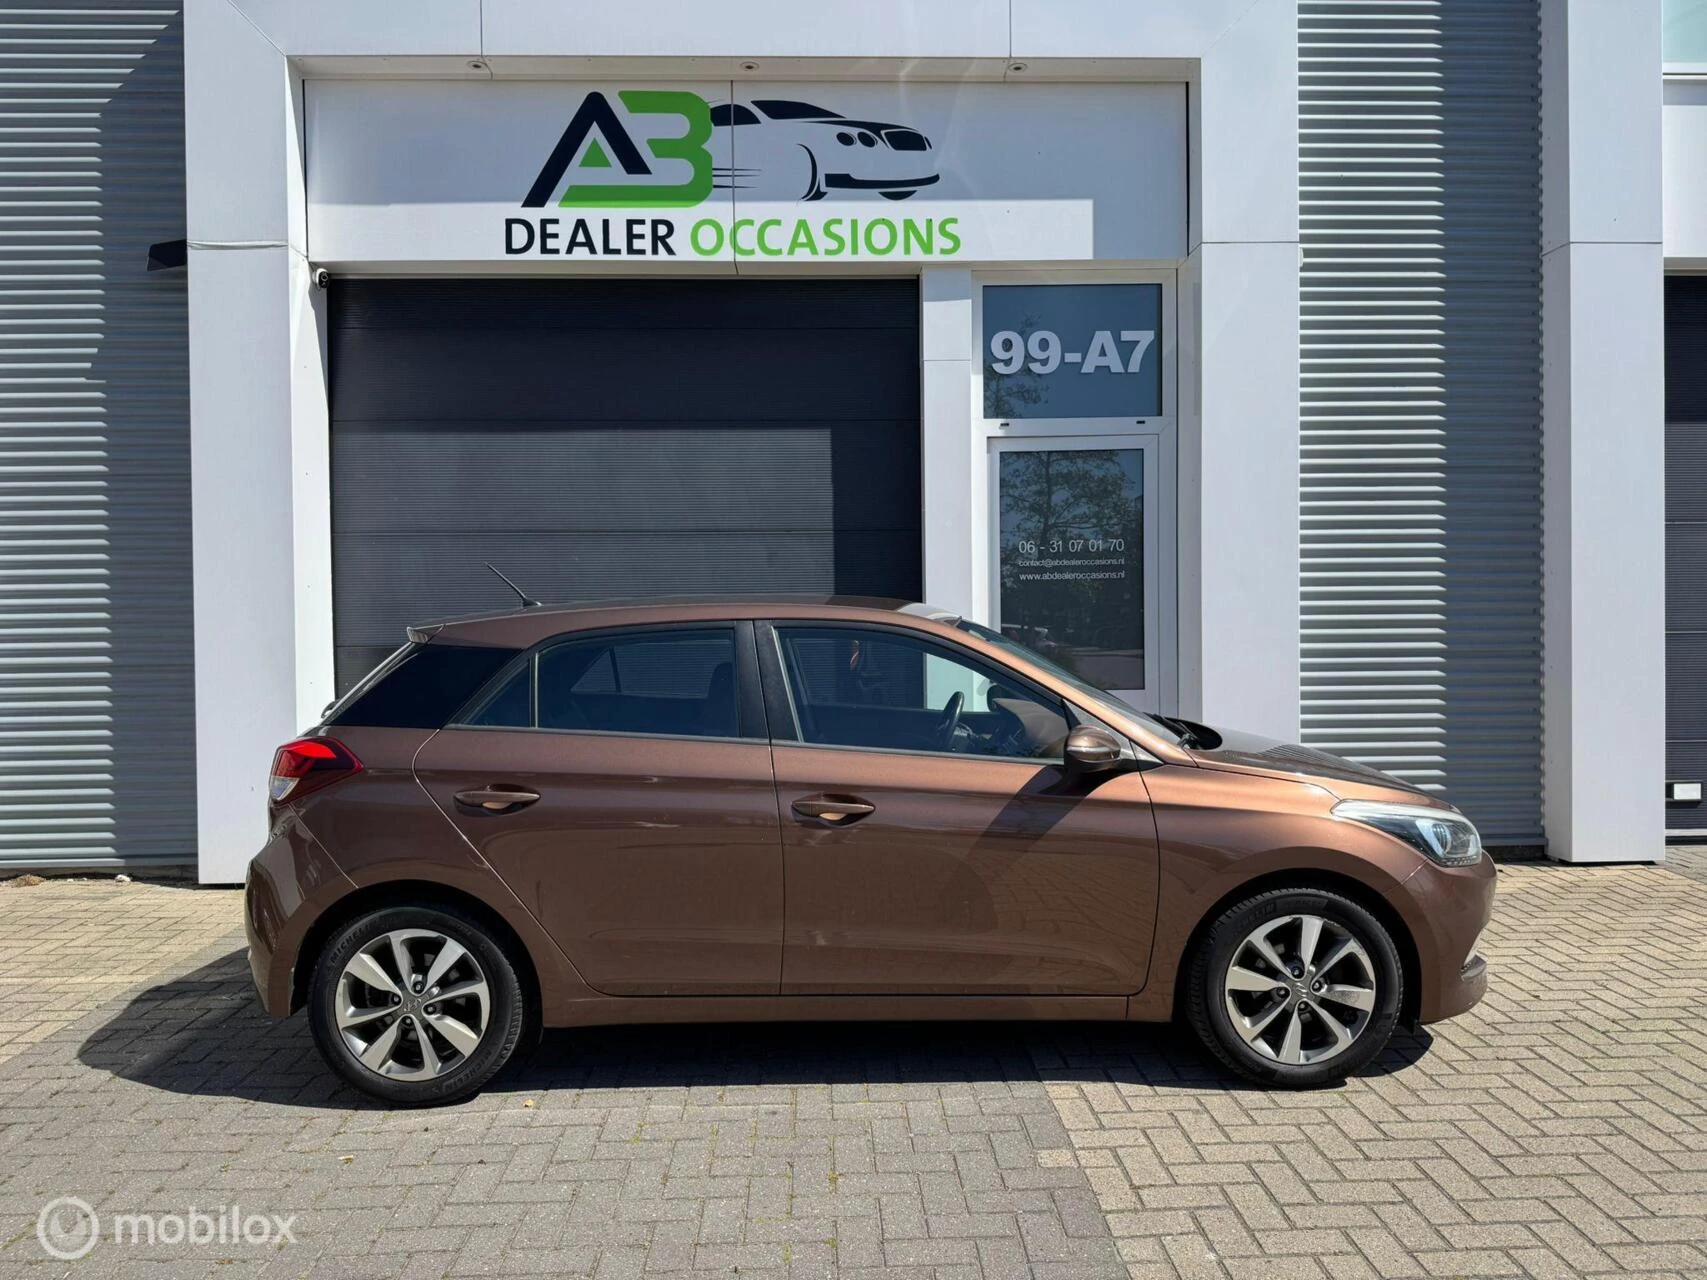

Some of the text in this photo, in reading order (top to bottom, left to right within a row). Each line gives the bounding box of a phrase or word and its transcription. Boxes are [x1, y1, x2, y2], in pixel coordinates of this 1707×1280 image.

[504, 217, 962, 257] DEALER OCCASIONS
[990, 330, 1155, 375] 99-A7
[1018, 540, 1036, 554] 06
[1049, 540, 1063, 553] 31
[1068, 540, 1084, 552] 07
[1088, 539, 1103, 552] 01
[1108, 538, 1125, 552] 70
[1019, 570, 1125, 580] www.abdealeroccasions.nl
